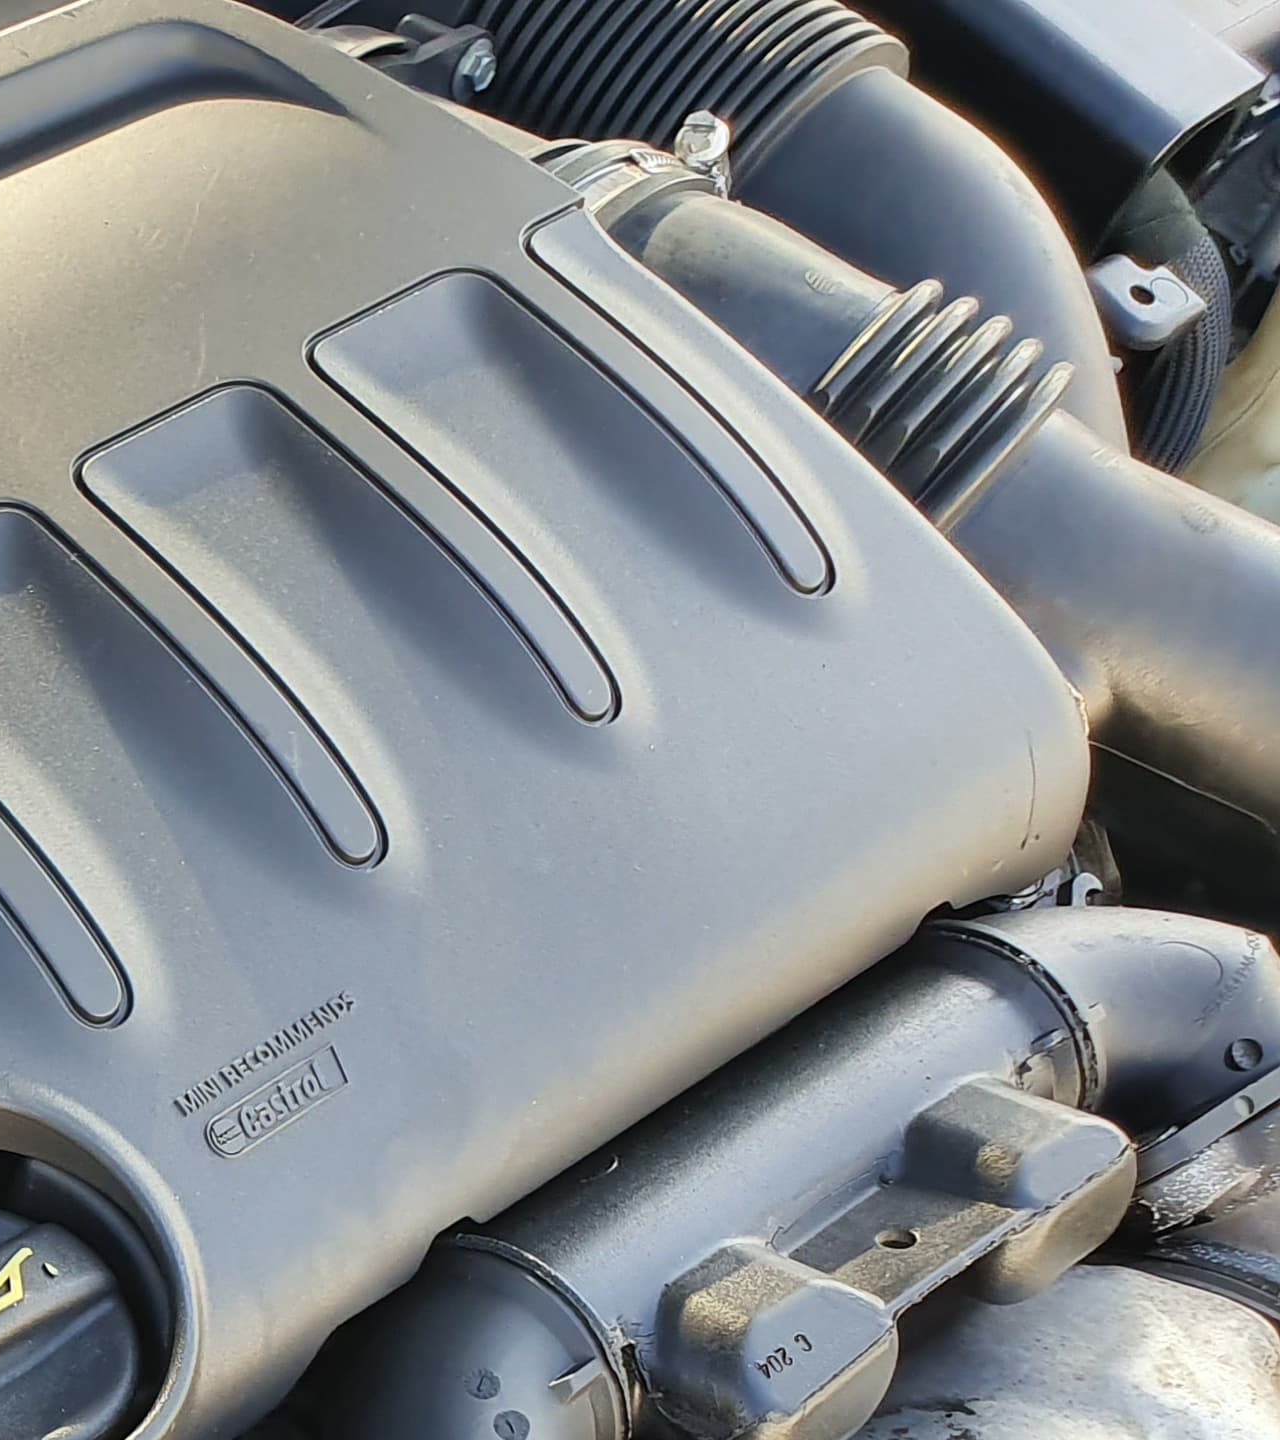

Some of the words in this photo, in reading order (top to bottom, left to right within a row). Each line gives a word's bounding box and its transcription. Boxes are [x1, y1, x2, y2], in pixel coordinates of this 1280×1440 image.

[173, 1073, 223, 1118] MINI
[221, 990, 356, 1089] RECOMMENDS
[238, 1059, 331, 1141] Castrol
